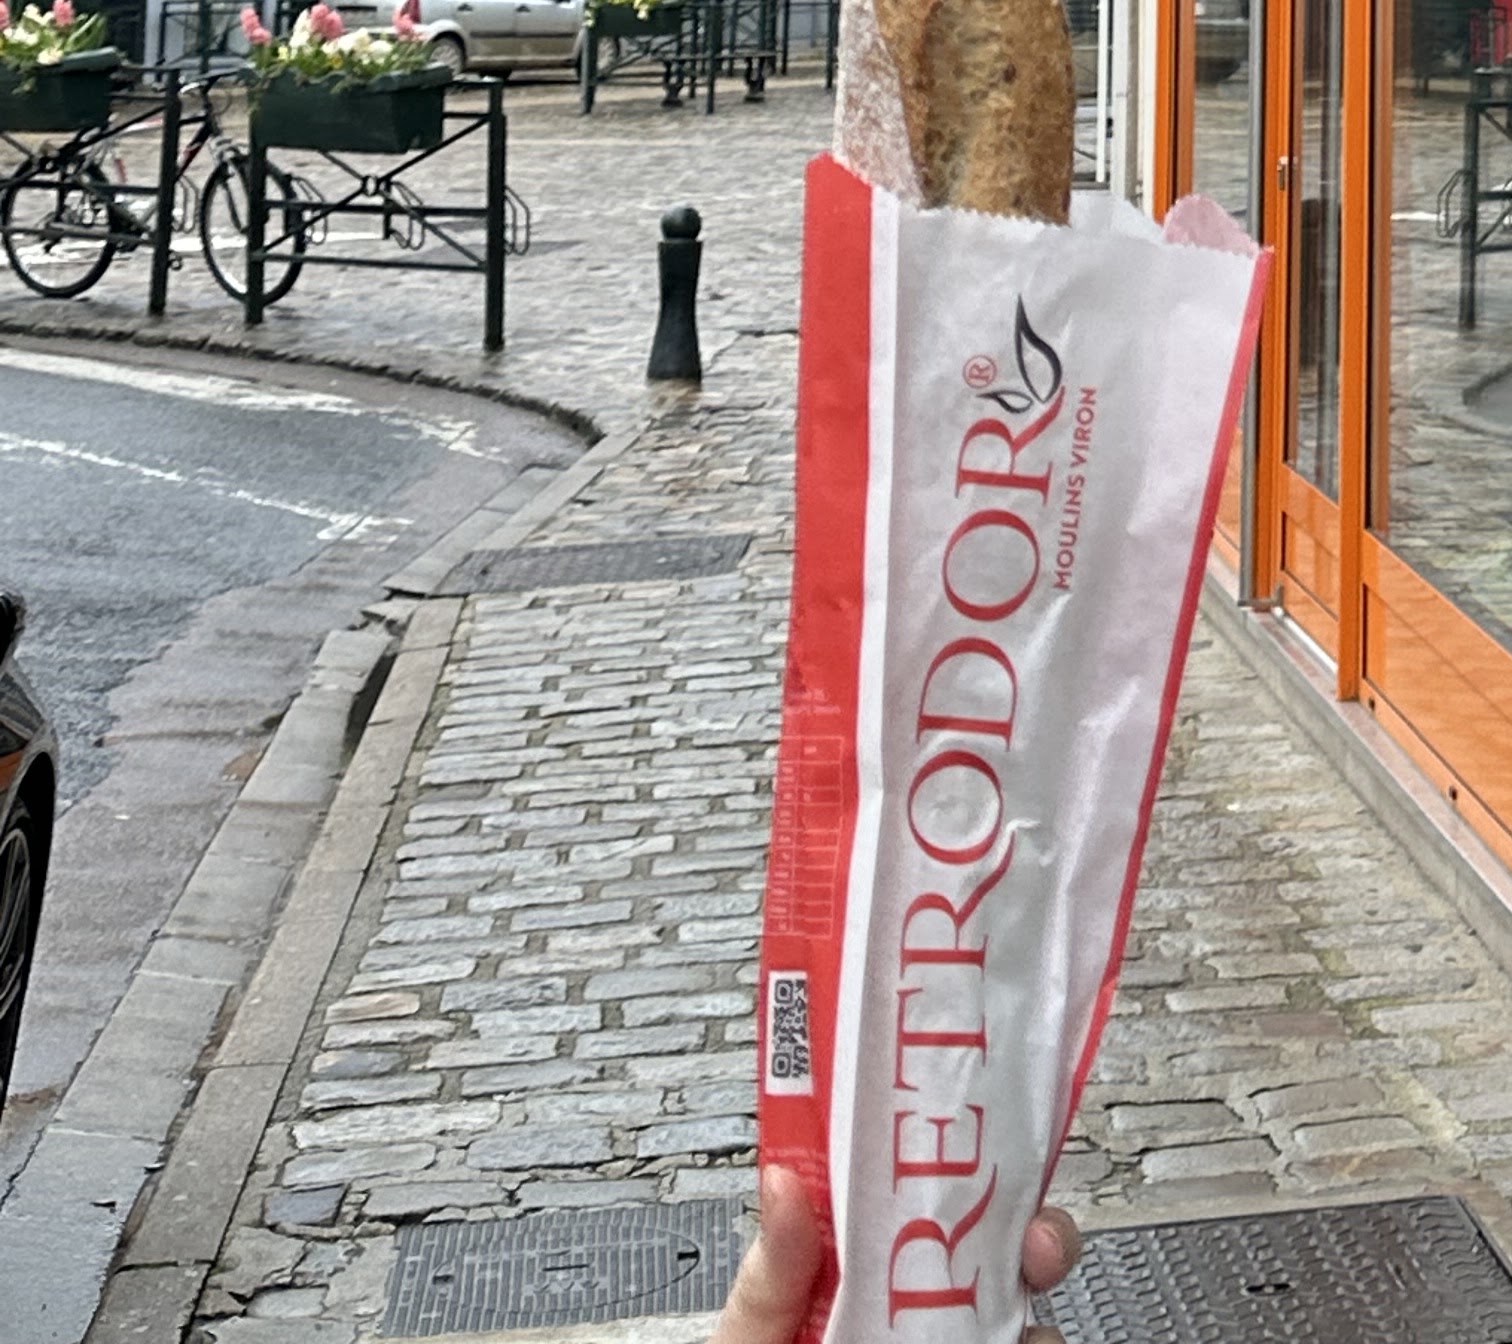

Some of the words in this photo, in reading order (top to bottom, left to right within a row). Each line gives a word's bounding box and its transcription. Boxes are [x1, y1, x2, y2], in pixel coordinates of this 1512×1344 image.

[1054, 473, 1086, 590] MOULINS
[1070, 386, 1097, 469] VIRON
[888, 384, 1067, 1331] RETRODOR
